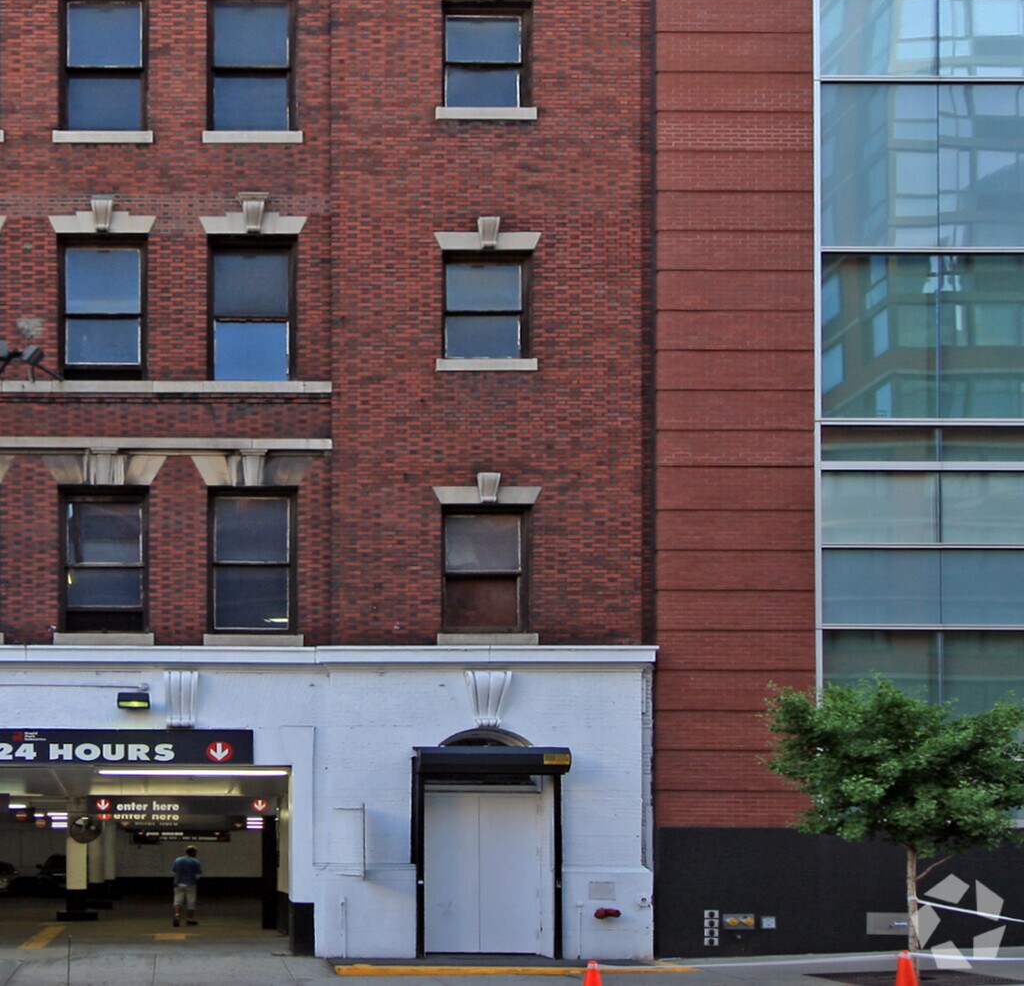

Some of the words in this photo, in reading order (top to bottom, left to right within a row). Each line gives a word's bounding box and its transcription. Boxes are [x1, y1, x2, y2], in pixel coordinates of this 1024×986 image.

[49, 743, 175, 761] HOURS
[116, 802, 148, 811] enter
[152, 801, 180, 811] here
